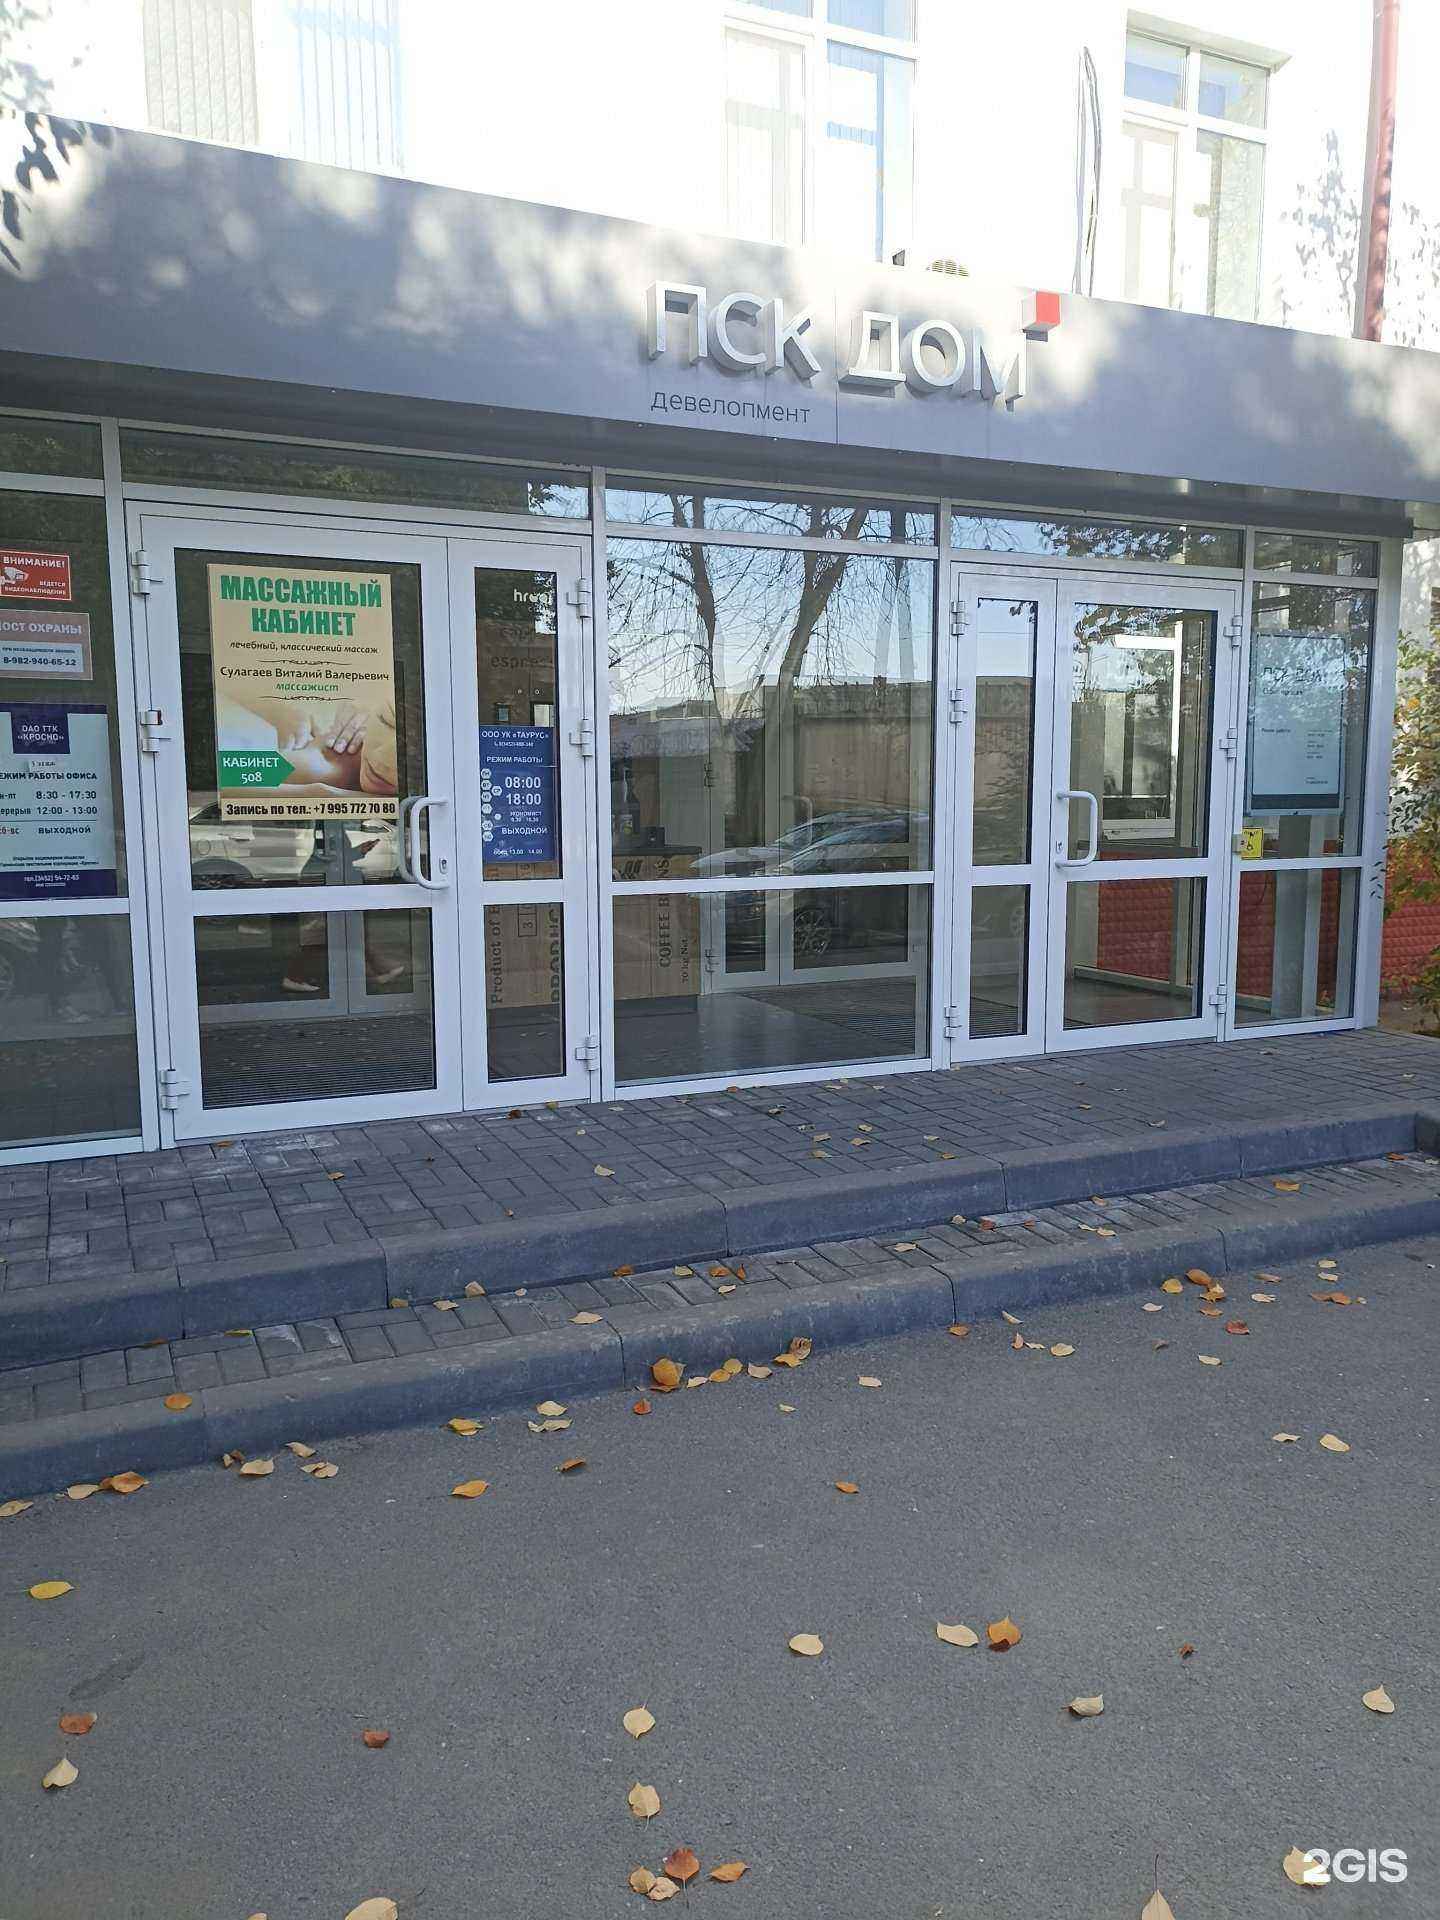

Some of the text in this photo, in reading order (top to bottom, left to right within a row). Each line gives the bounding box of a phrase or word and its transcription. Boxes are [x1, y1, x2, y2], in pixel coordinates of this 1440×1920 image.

[646, 280, 1028, 402] ПСК ДОМ
[650, 390, 812, 424] девелопмент
[2, 556, 65, 568] ВНИМАНИЕ!
[220, 575, 382, 607] МАССАЖНЫЙ
[251, 607, 356, 636] КАБИНЕТ
[28, 624, 82, 635] ОХРАНЫ
[230, 641, 378, 654] лечебный, классический массаж
[220, 667, 390, 682] Сулагаев Виталий Валерьевич
[275, 683, 339, 692] массажист
[223, 757, 279, 768] КАБИНЕТ
[513, 756, 543, 764] РАБОТЫ
[0, 772, 98, 780] ЕЖИМ РАБОТЫ ОФИСА
[241, 772, 262, 785] 508
[504, 776, 541, 789] 08:00
[35, 791, 58, 800] 8:30
[69, 791, 97, 799] 17:30
[505, 793, 542, 806] 18:00
[1, 807, 31, 817] ерерыв
[37, 807, 63, 815] 12:00
[72, 807, 98, 815] 13:00
[226, 803, 396, 815] Запись по тел.: +7 995 772 70 80
[488, 920, 501, 936] of
[658, 912, 672, 968] COFFEE
[489, 941, 503, 1004] Product
